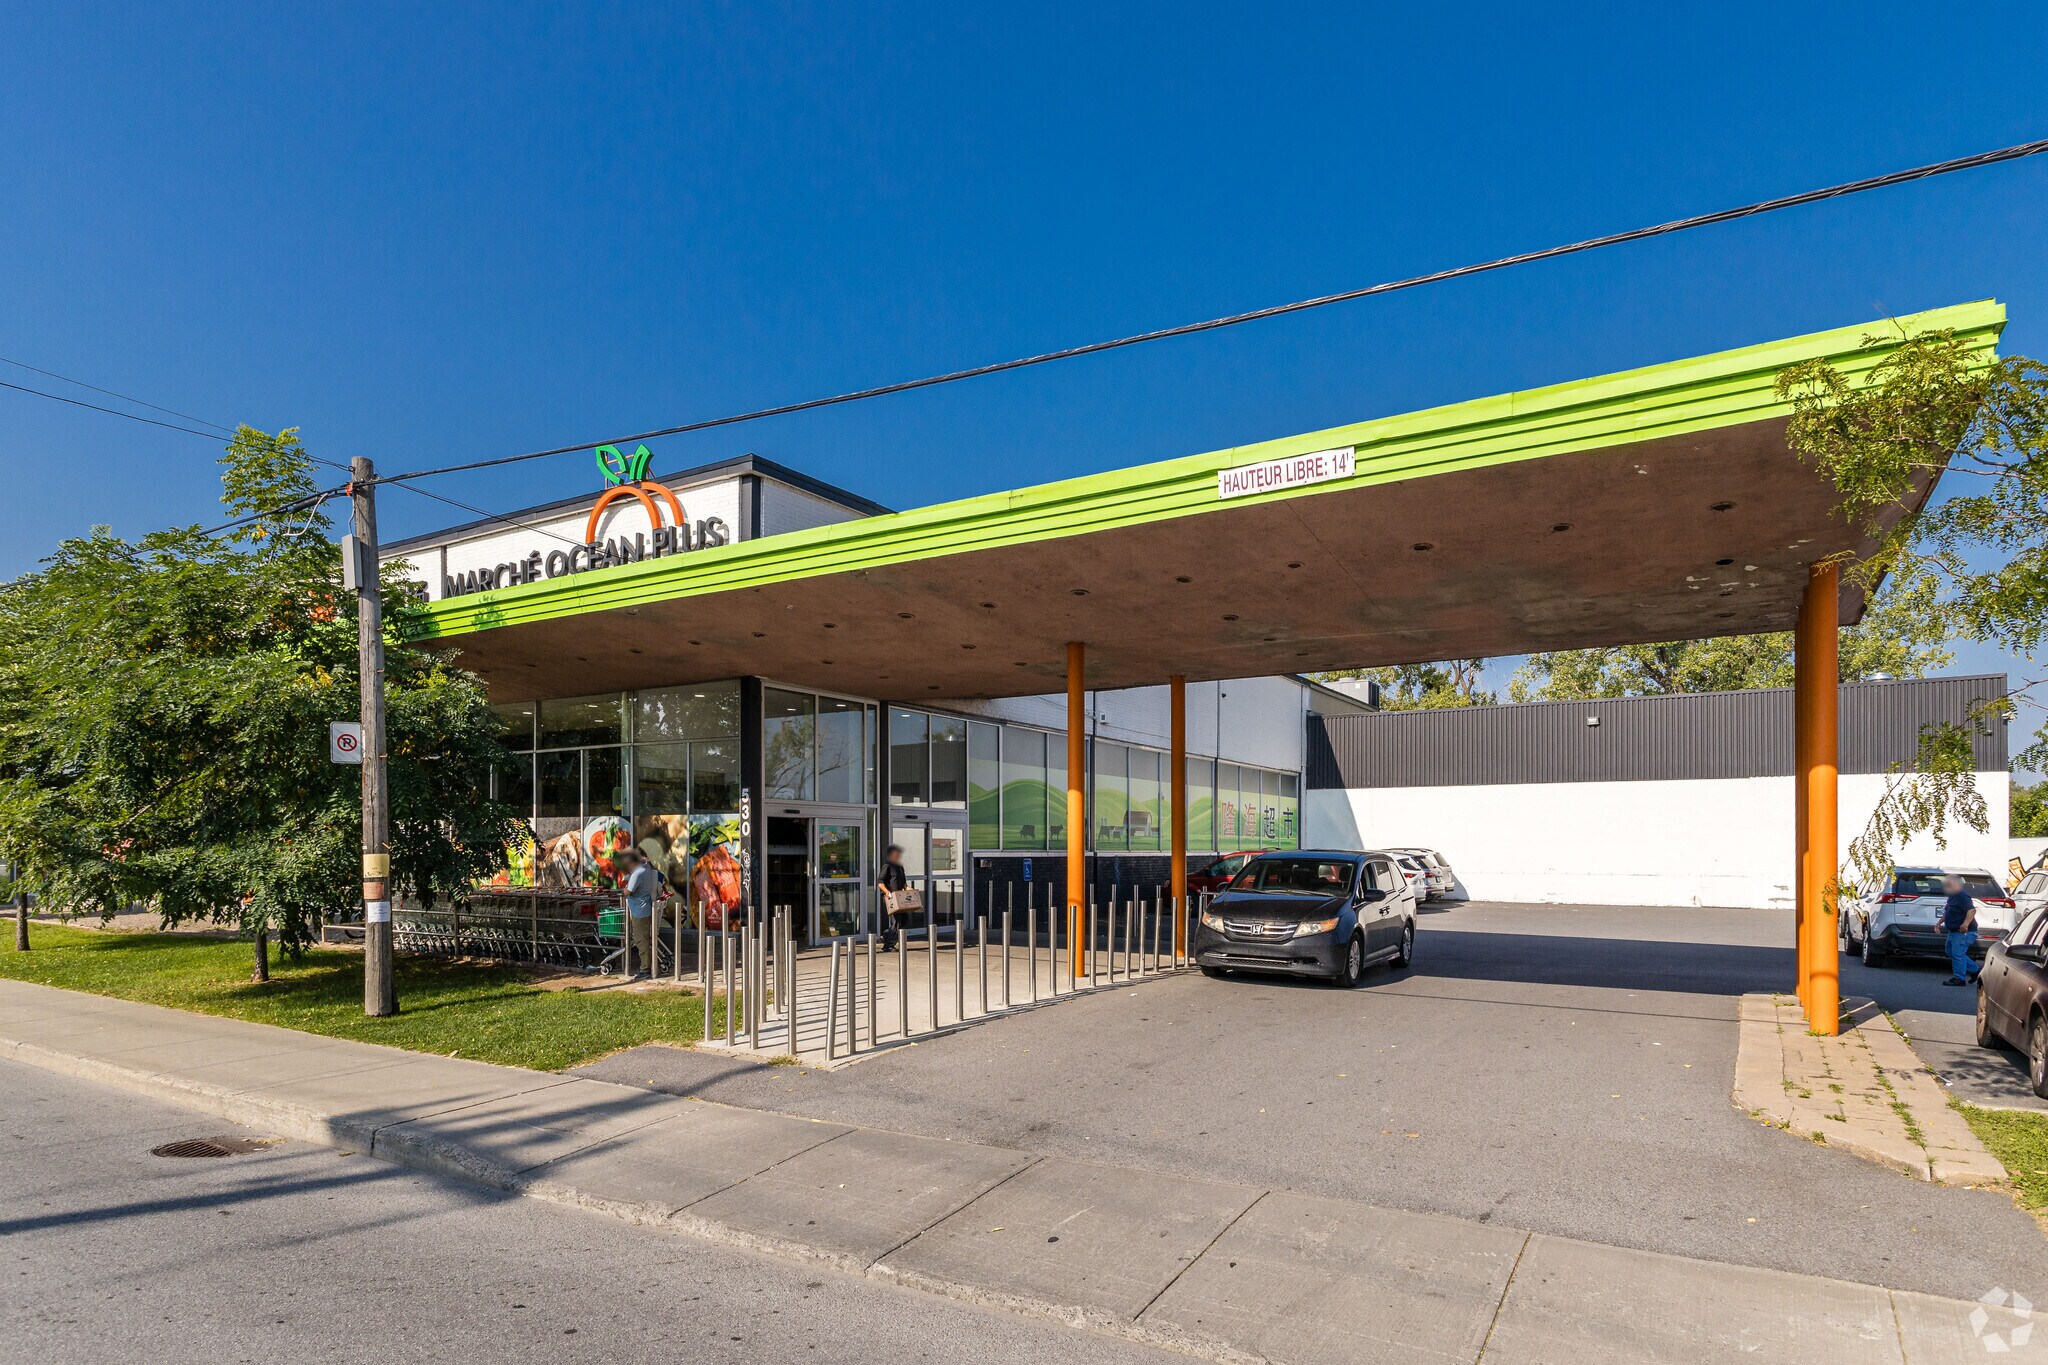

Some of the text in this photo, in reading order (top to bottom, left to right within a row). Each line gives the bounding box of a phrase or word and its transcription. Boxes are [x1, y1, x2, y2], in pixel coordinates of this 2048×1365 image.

[1223, 452, 1349, 493] HAUTEUR LIBRE: 14'
[446, 550, 543, 598] MARCHÉ
[545, 532, 645, 579] OCEAN
[652, 516, 724, 559] PLUS
[742, 788, 751, 836] 530
